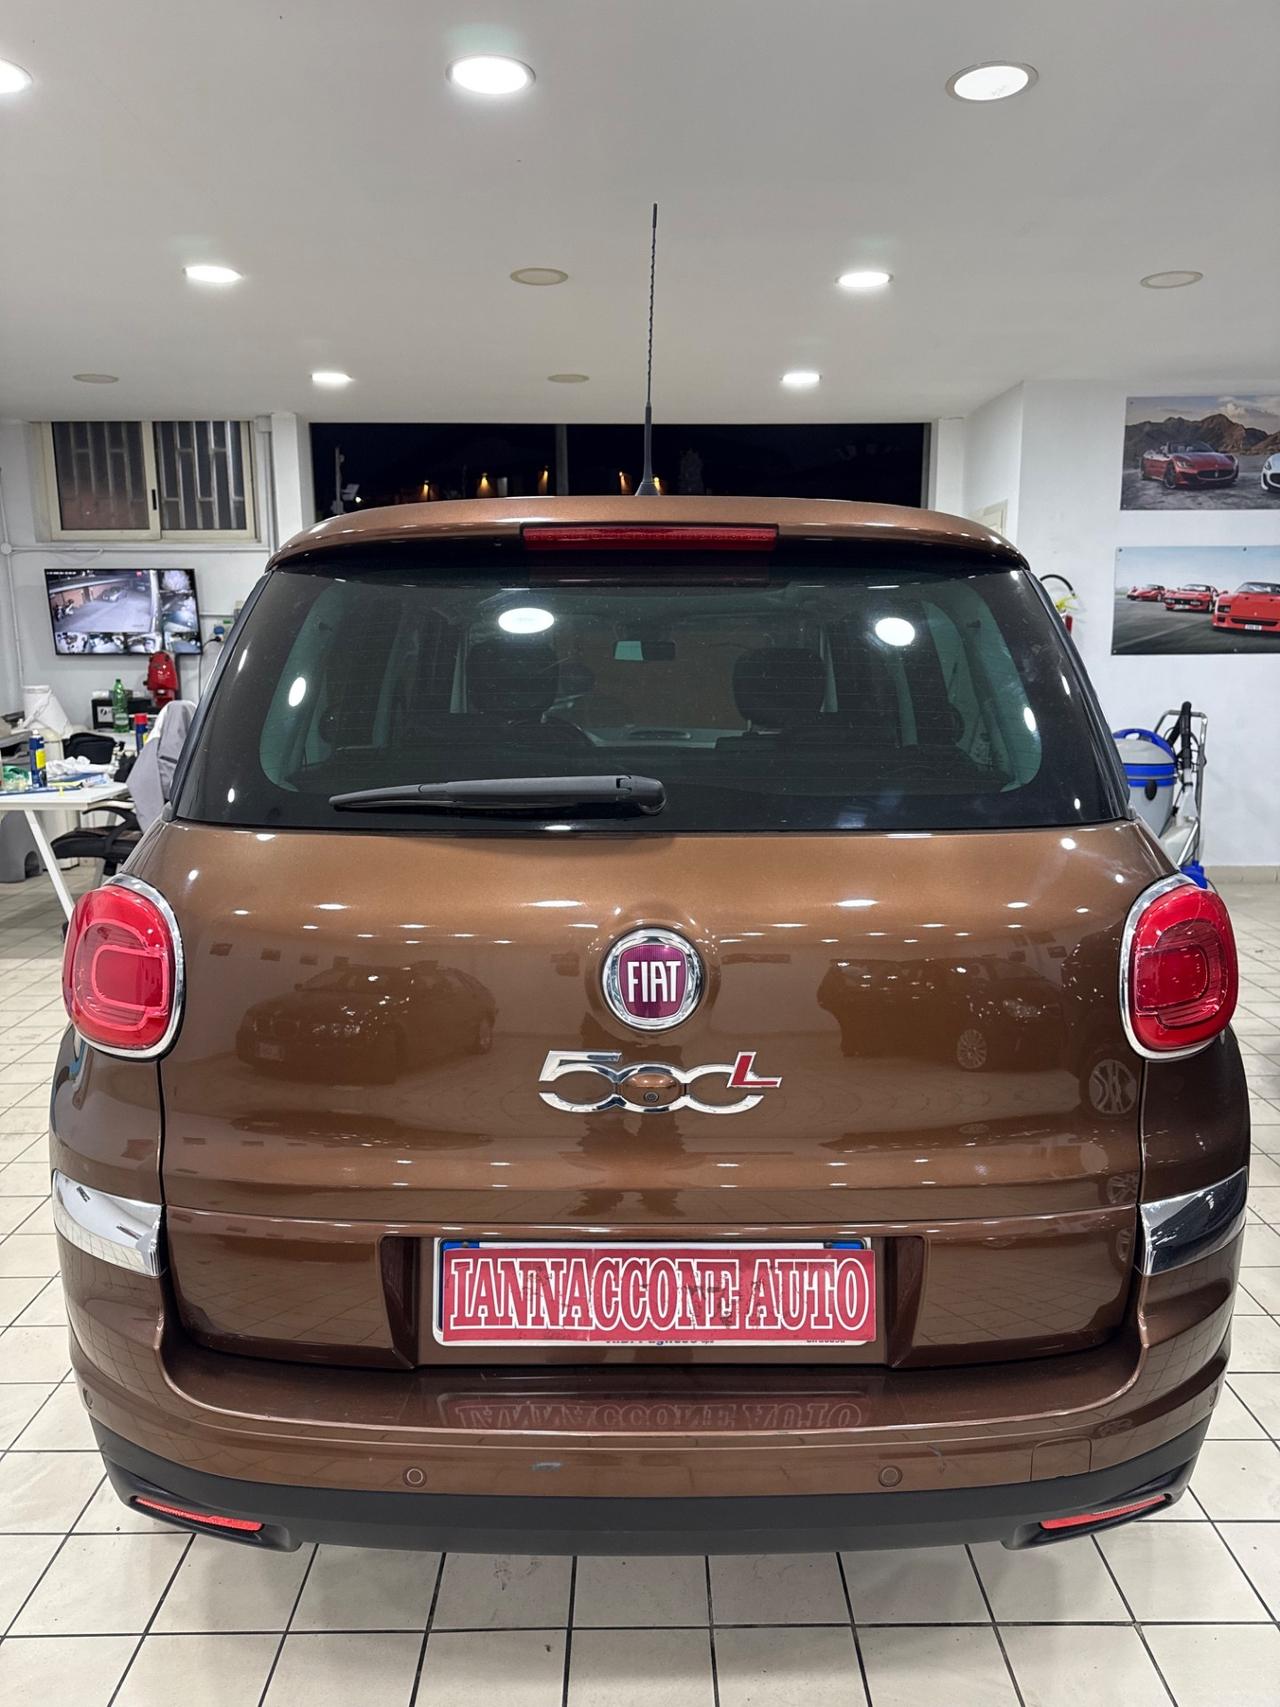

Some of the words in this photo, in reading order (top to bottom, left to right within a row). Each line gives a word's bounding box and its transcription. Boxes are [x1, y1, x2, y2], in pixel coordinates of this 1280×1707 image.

[627, 961, 681, 1003] FIAT
[449, 1257, 740, 1331] IANNACCONE
[745, 1257, 870, 1331] AUTO
